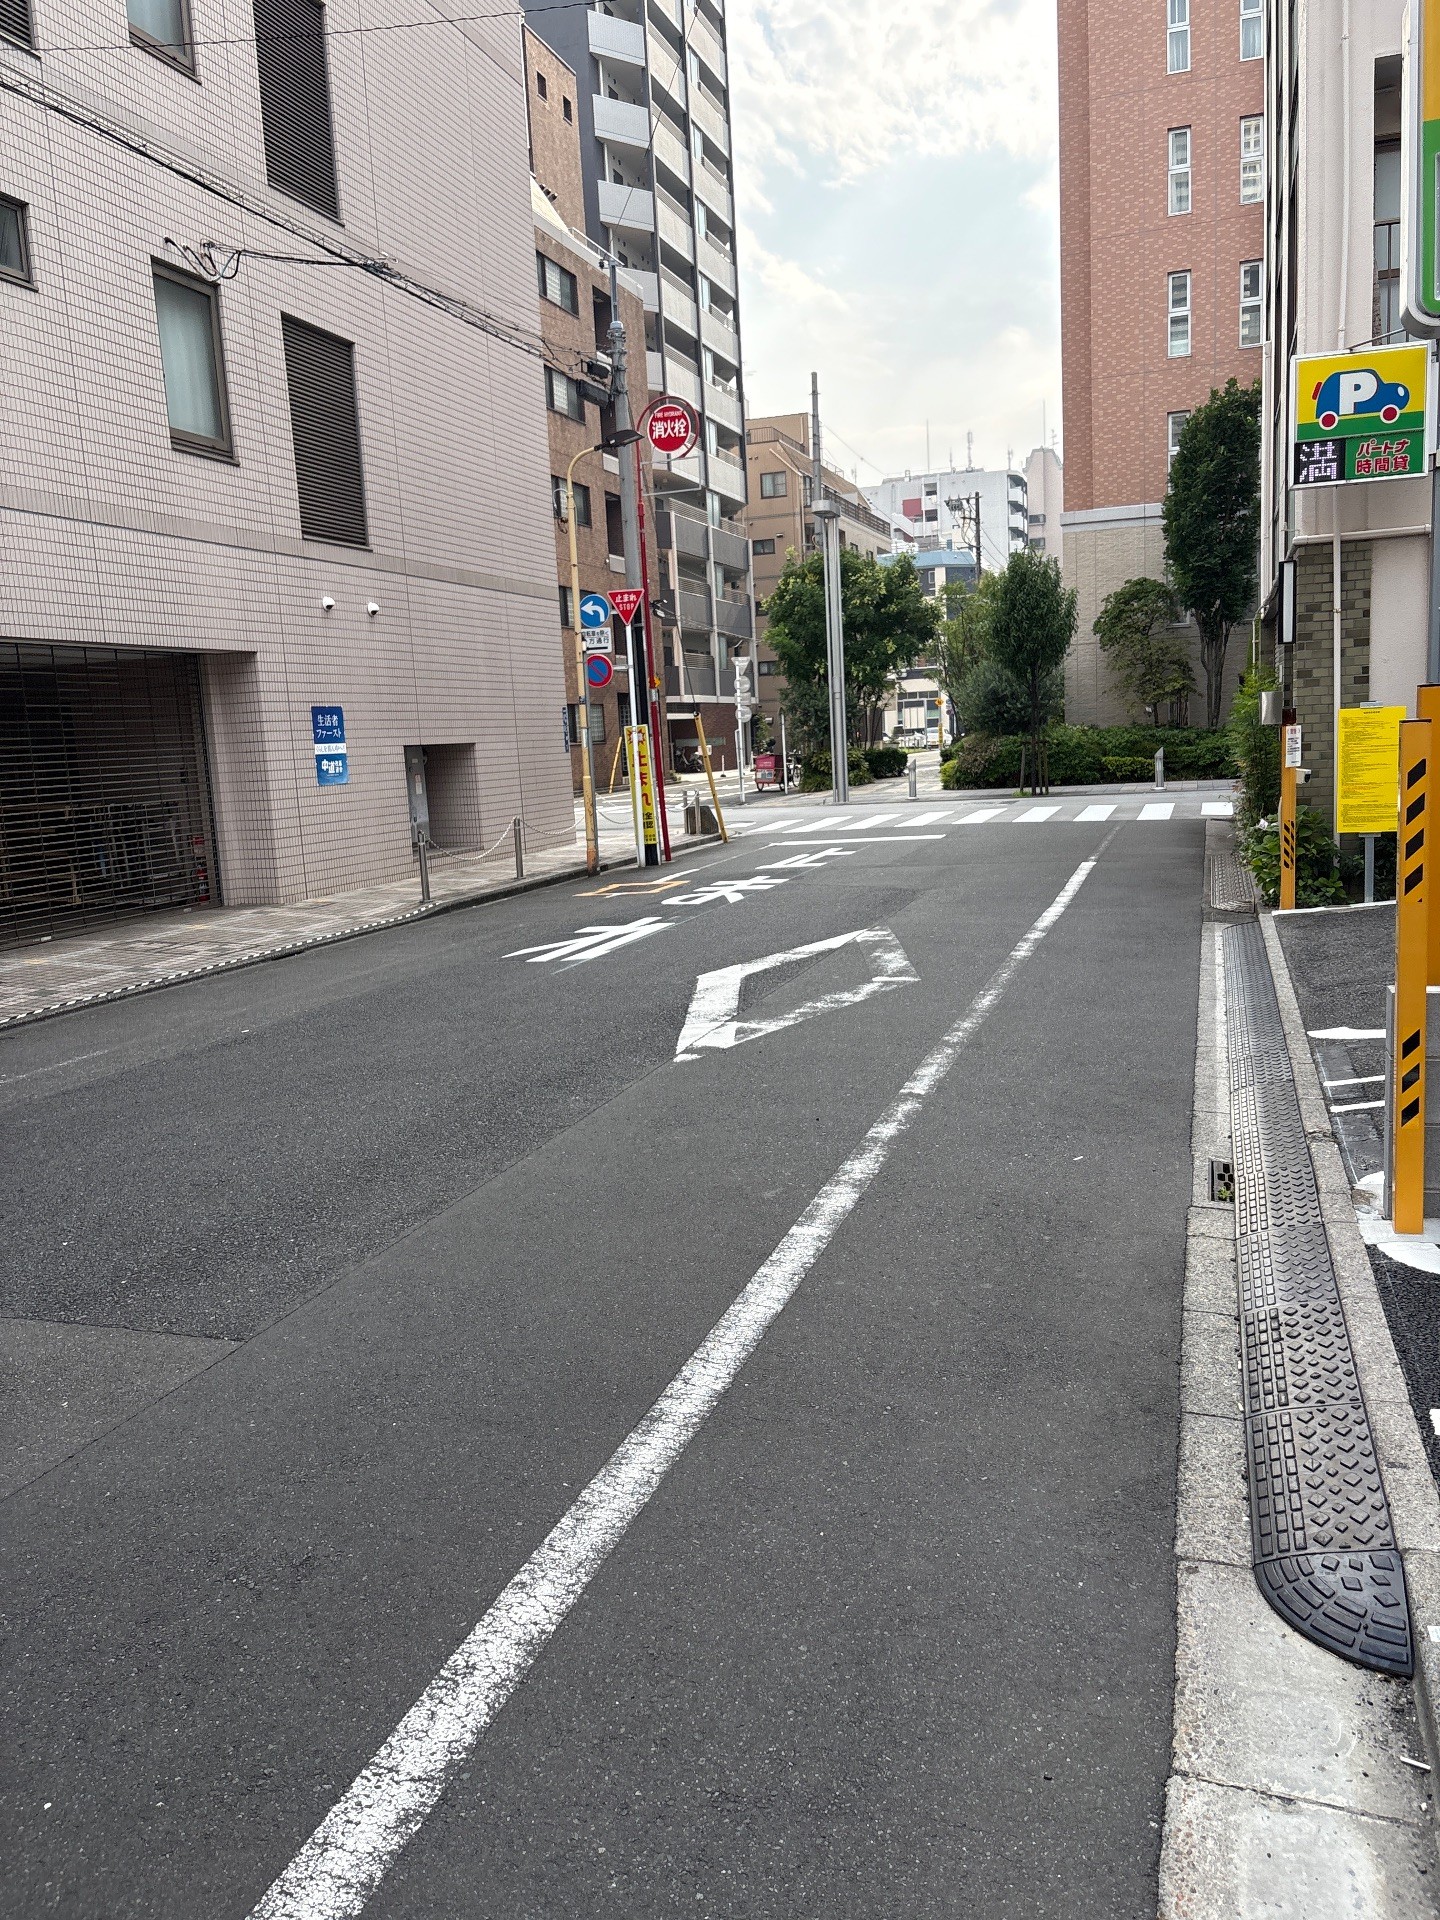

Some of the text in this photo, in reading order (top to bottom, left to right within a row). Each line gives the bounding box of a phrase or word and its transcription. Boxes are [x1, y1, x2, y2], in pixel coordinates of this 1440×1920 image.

[1339, 371, 1378, 416] P
[664, 410, 683, 418] HYDRANT
[651, 417, 687, 440] 消火栓
[1299, 441, 1338, 483] 満
[1355, 455, 1410, 476] 時間貸
[616, 593, 640, 604] 止まれ
[620, 604, 638, 613] STOP
[586, 636, 610, 645] 方通行
[317, 714, 338, 726] 生活者
[316, 728, 342, 738] ファースト
[321, 759, 335, 774] 中道
[501, 847, 857, 963] 止まれ
